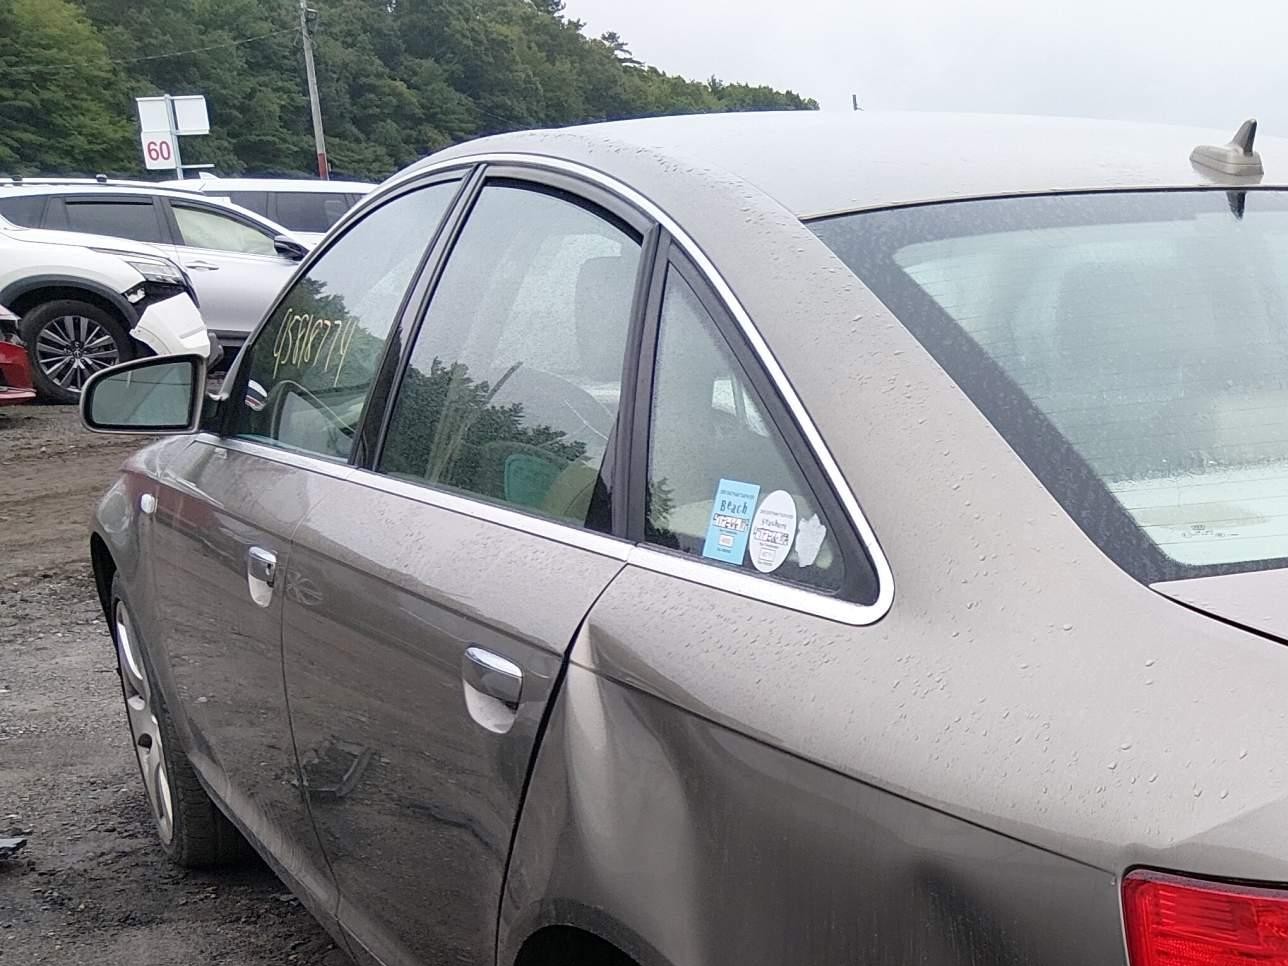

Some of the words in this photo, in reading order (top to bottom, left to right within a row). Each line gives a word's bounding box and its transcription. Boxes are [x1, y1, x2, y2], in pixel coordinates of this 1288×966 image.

[147, 140, 172, 162] 60
[273, 308, 358, 388] 45818774
[720, 499, 748, 515] Beach
